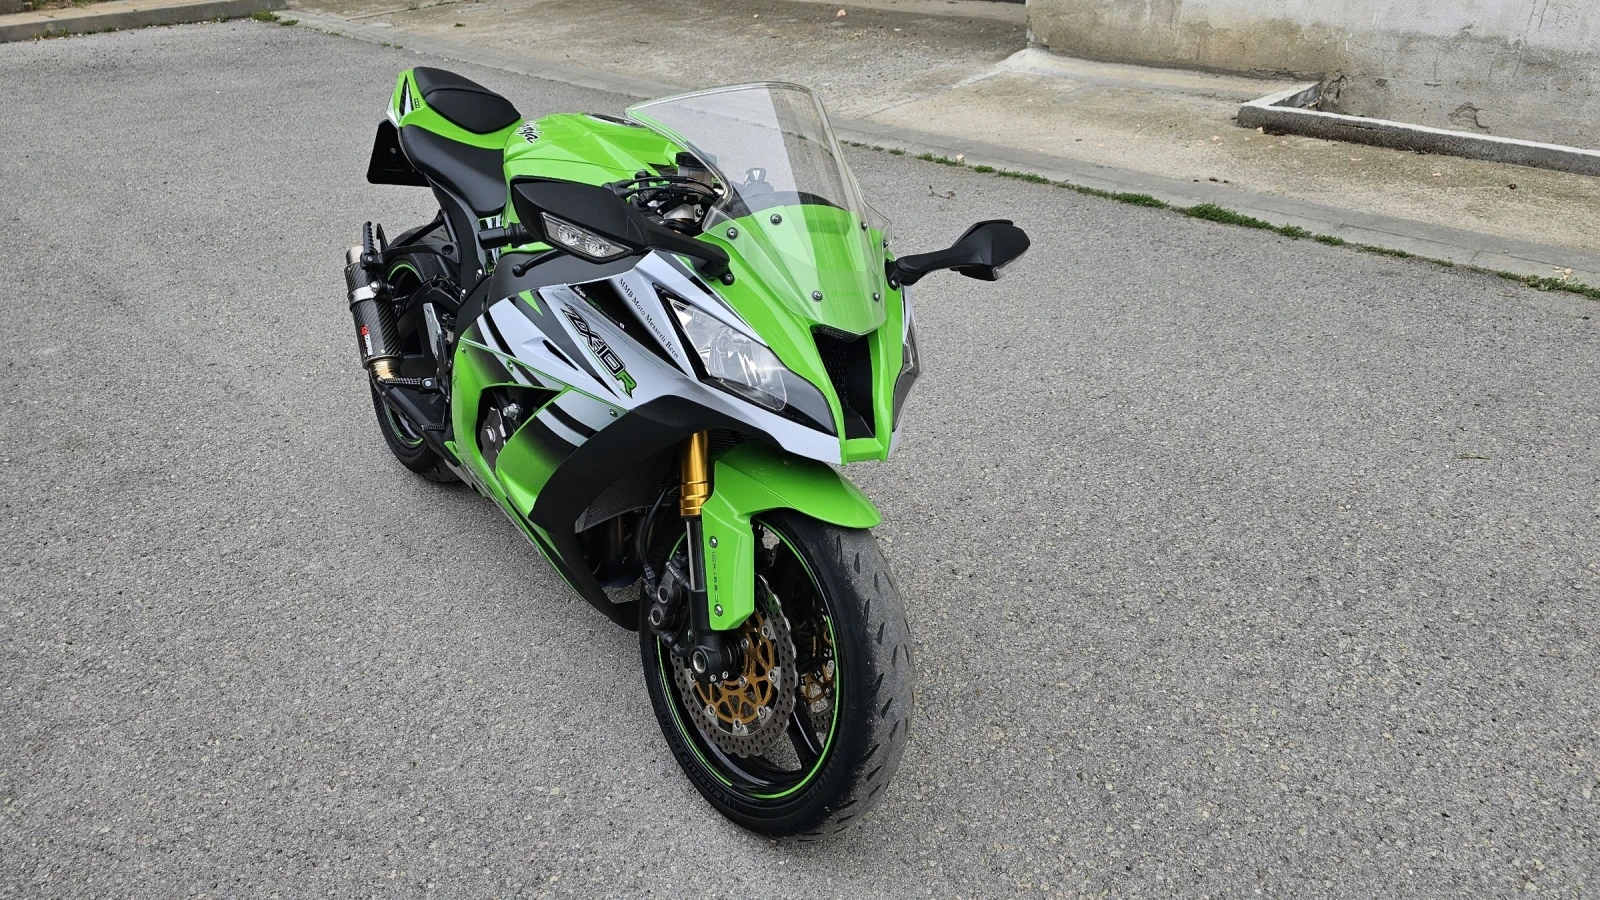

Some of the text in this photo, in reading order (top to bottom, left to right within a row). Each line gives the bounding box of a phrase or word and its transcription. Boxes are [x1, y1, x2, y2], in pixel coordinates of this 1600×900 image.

[618, 277, 634, 298] MMB
[632, 297, 646, 316] Moto
[644, 313, 666, 344] Messerli
[681, 753, 725, 800] MICHELIN
